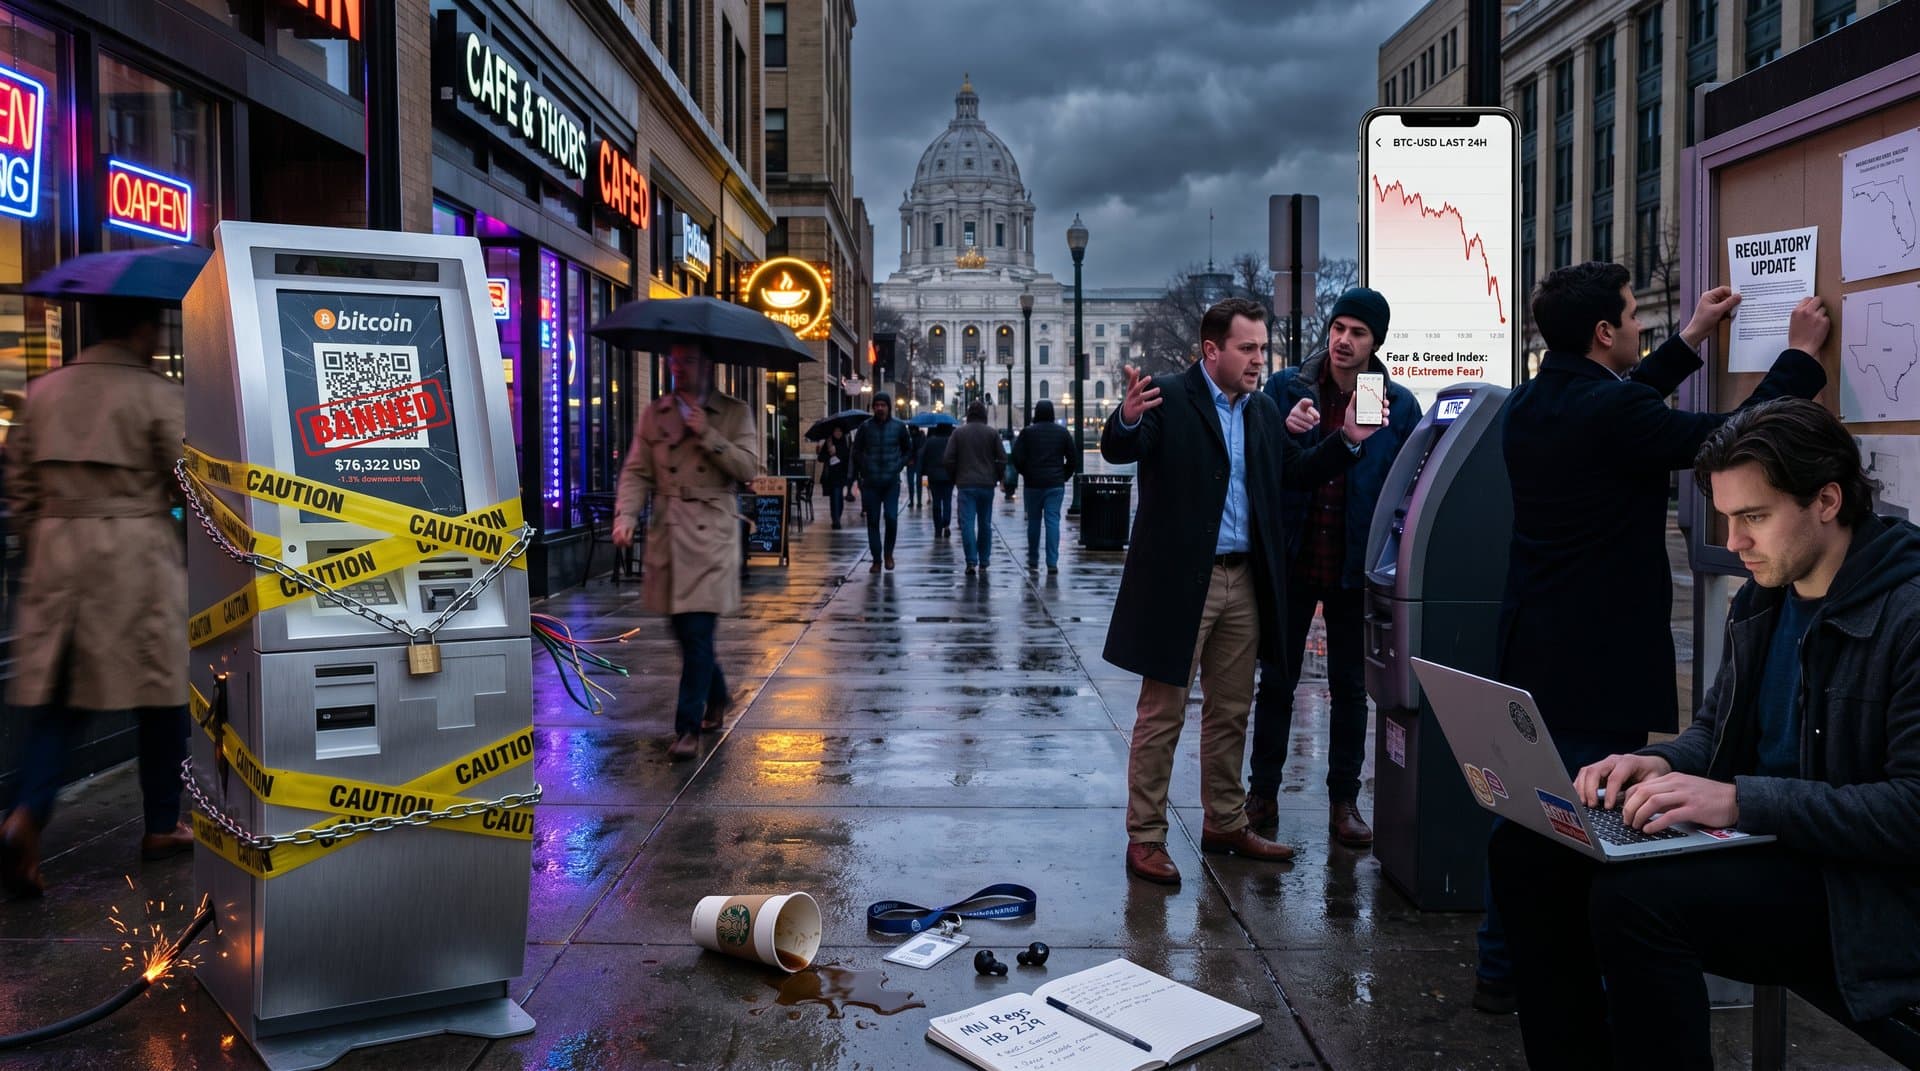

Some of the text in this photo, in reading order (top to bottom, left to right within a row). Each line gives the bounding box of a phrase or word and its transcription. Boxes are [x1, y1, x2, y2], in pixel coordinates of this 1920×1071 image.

[467, 33, 518, 127] CAFE
[522, 81, 534, 140] &
[1392, 138, 1487, 147] BTC-USD LAST 24H
[600, 140, 649, 230] CAFED
[1735, 234, 1811, 259] REGULATORY
[1751, 256, 1796, 276] UPDATE
[337, 310, 412, 332] bitcoin
[1386, 352, 1488, 362] Fear & Greed Index:
[1391, 366, 1484, 378] 38 (Extreme Fear)
[310, 391, 437, 445] BANNED
[335, 459, 421, 473] $76,322 USD
[247, 469, 345, 514] CAUTION
[409, 514, 503, 555] CAUTION
[960, 1020, 989, 1036] MN
[989, 1008, 1031, 1024] Regs
[980, 1032, 1009, 1046] HB
